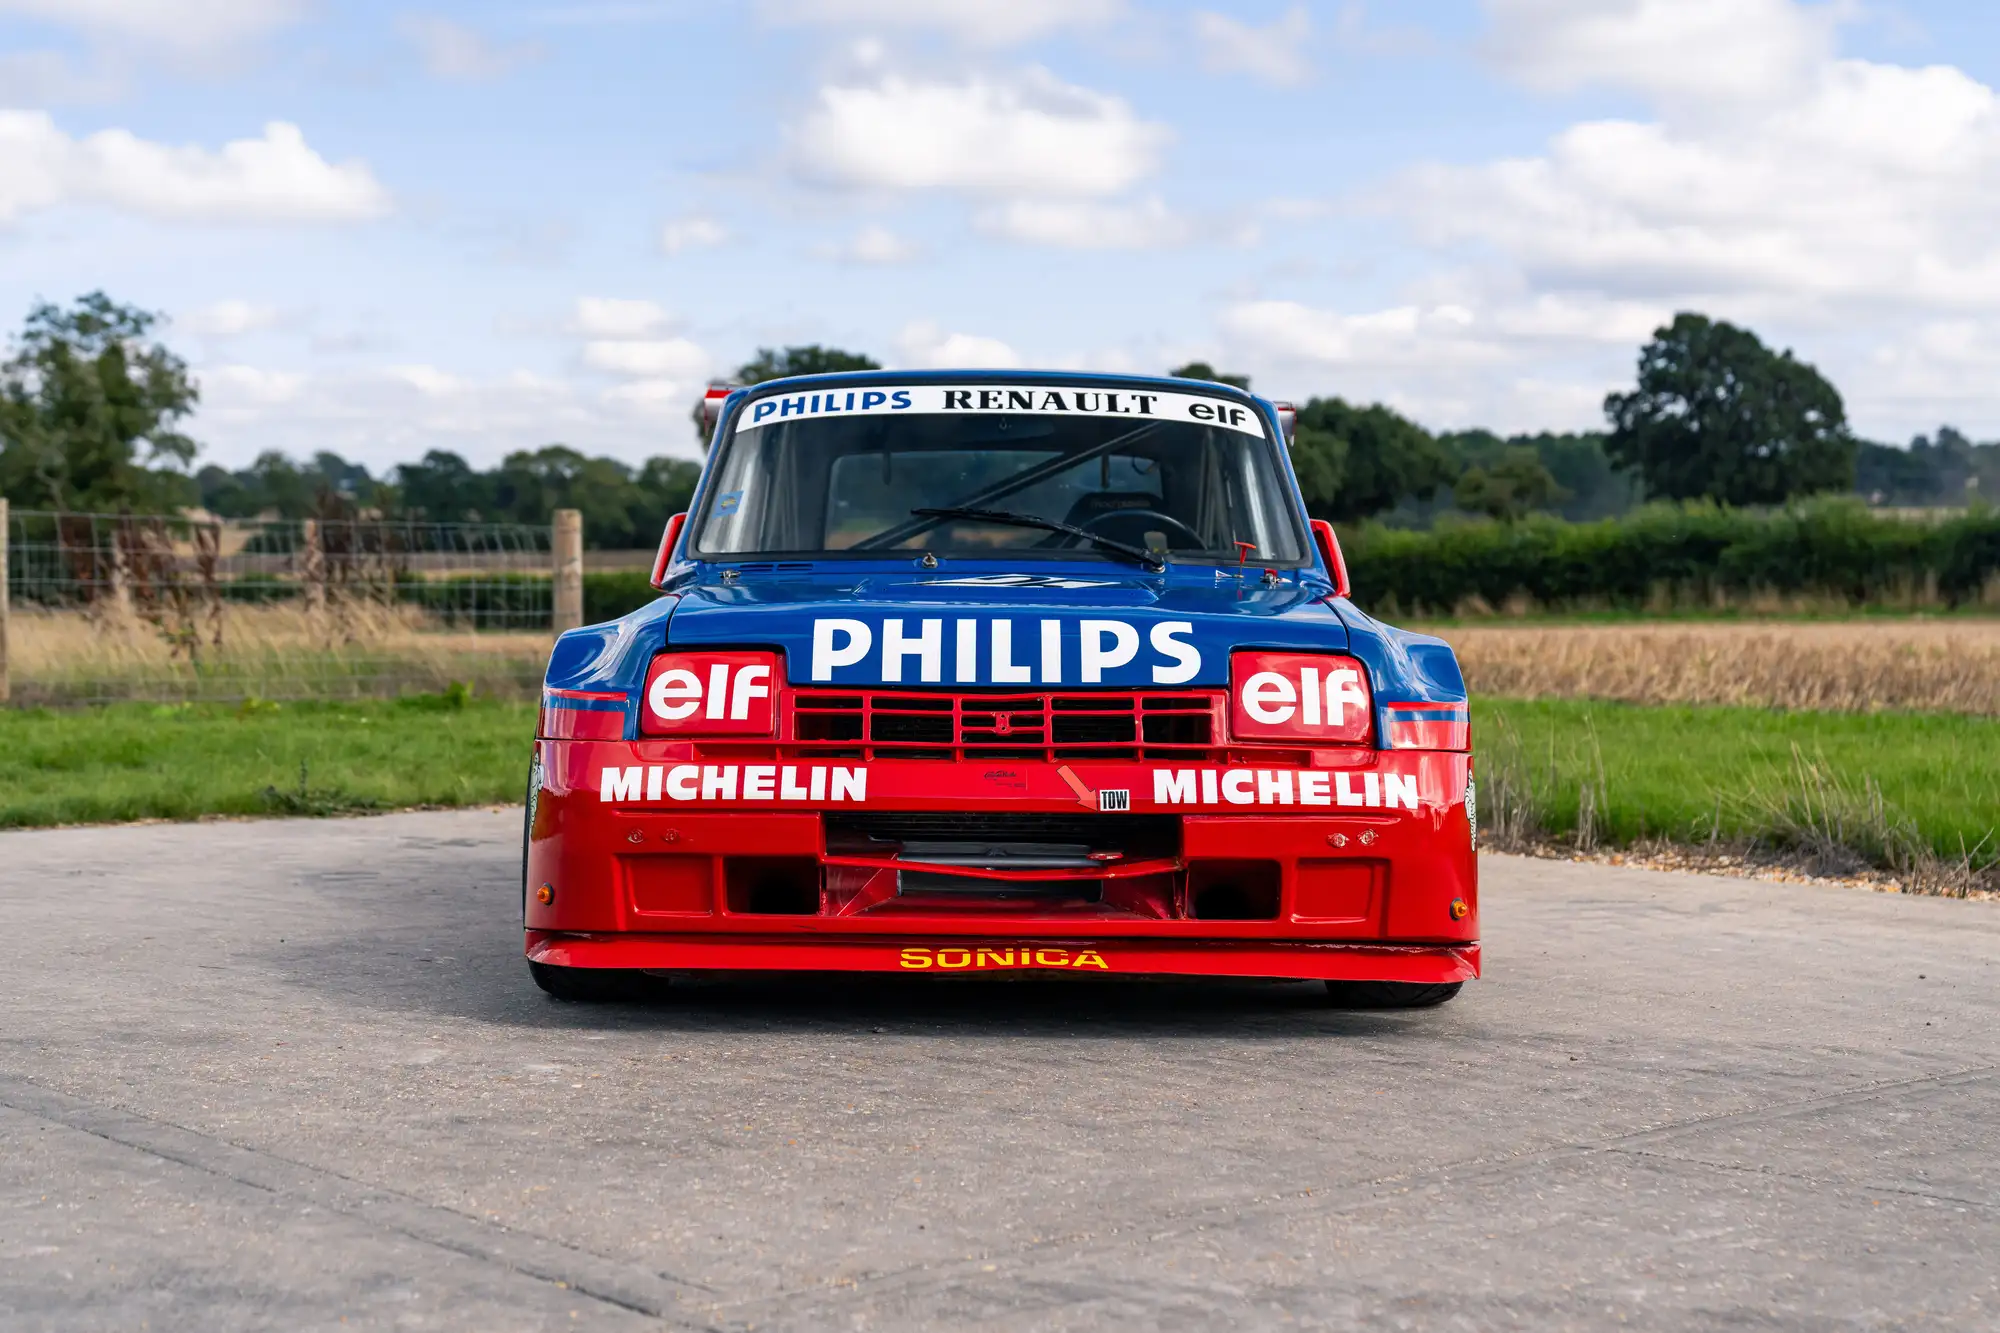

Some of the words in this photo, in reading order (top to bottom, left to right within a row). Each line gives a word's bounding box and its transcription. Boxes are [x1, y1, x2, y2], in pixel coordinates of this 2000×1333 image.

[753, 391, 912, 423] PHILIPS
[942, 390, 1158, 415] RENAULT
[1188, 403, 1246, 426] elf
[811, 618, 1202, 684] PHILIPS
[648, 664, 770, 720] elf
[1241, 666, 1365, 727] elf
[600, 764, 868, 802] MICHELIN
[1101, 790, 1127, 810] TOW
[1153, 769, 1419, 810] MICHELIN
[900, 947, 1109, 969] SONICA
